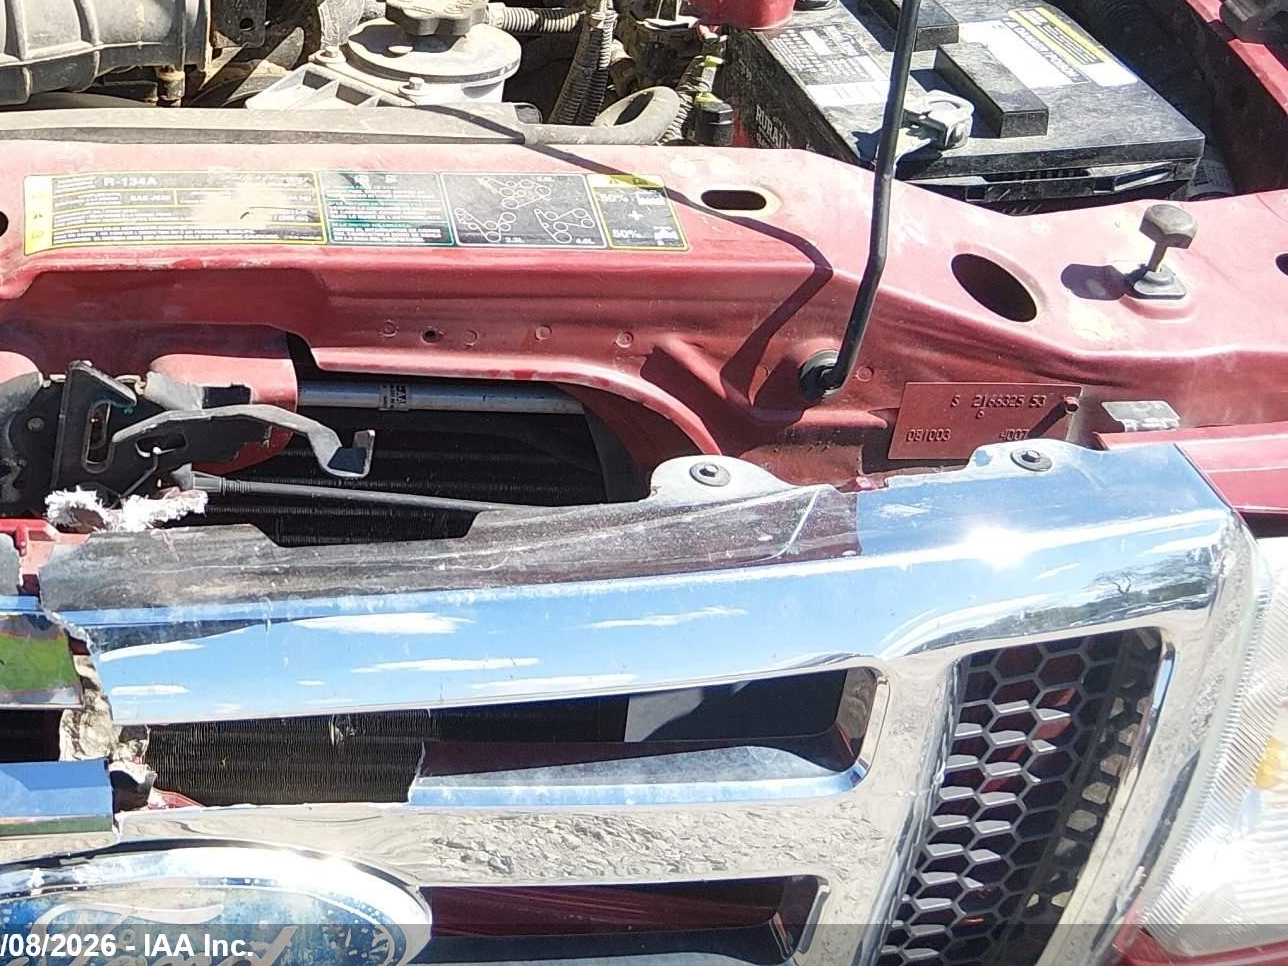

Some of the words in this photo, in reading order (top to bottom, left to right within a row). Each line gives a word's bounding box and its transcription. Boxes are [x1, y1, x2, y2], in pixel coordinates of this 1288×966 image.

[103, 176, 158, 187] R-134A
[599, 193, 629, 203] 50%
[612, 229, 642, 239] 50%
[1029, 394, 1047, 408] 53
